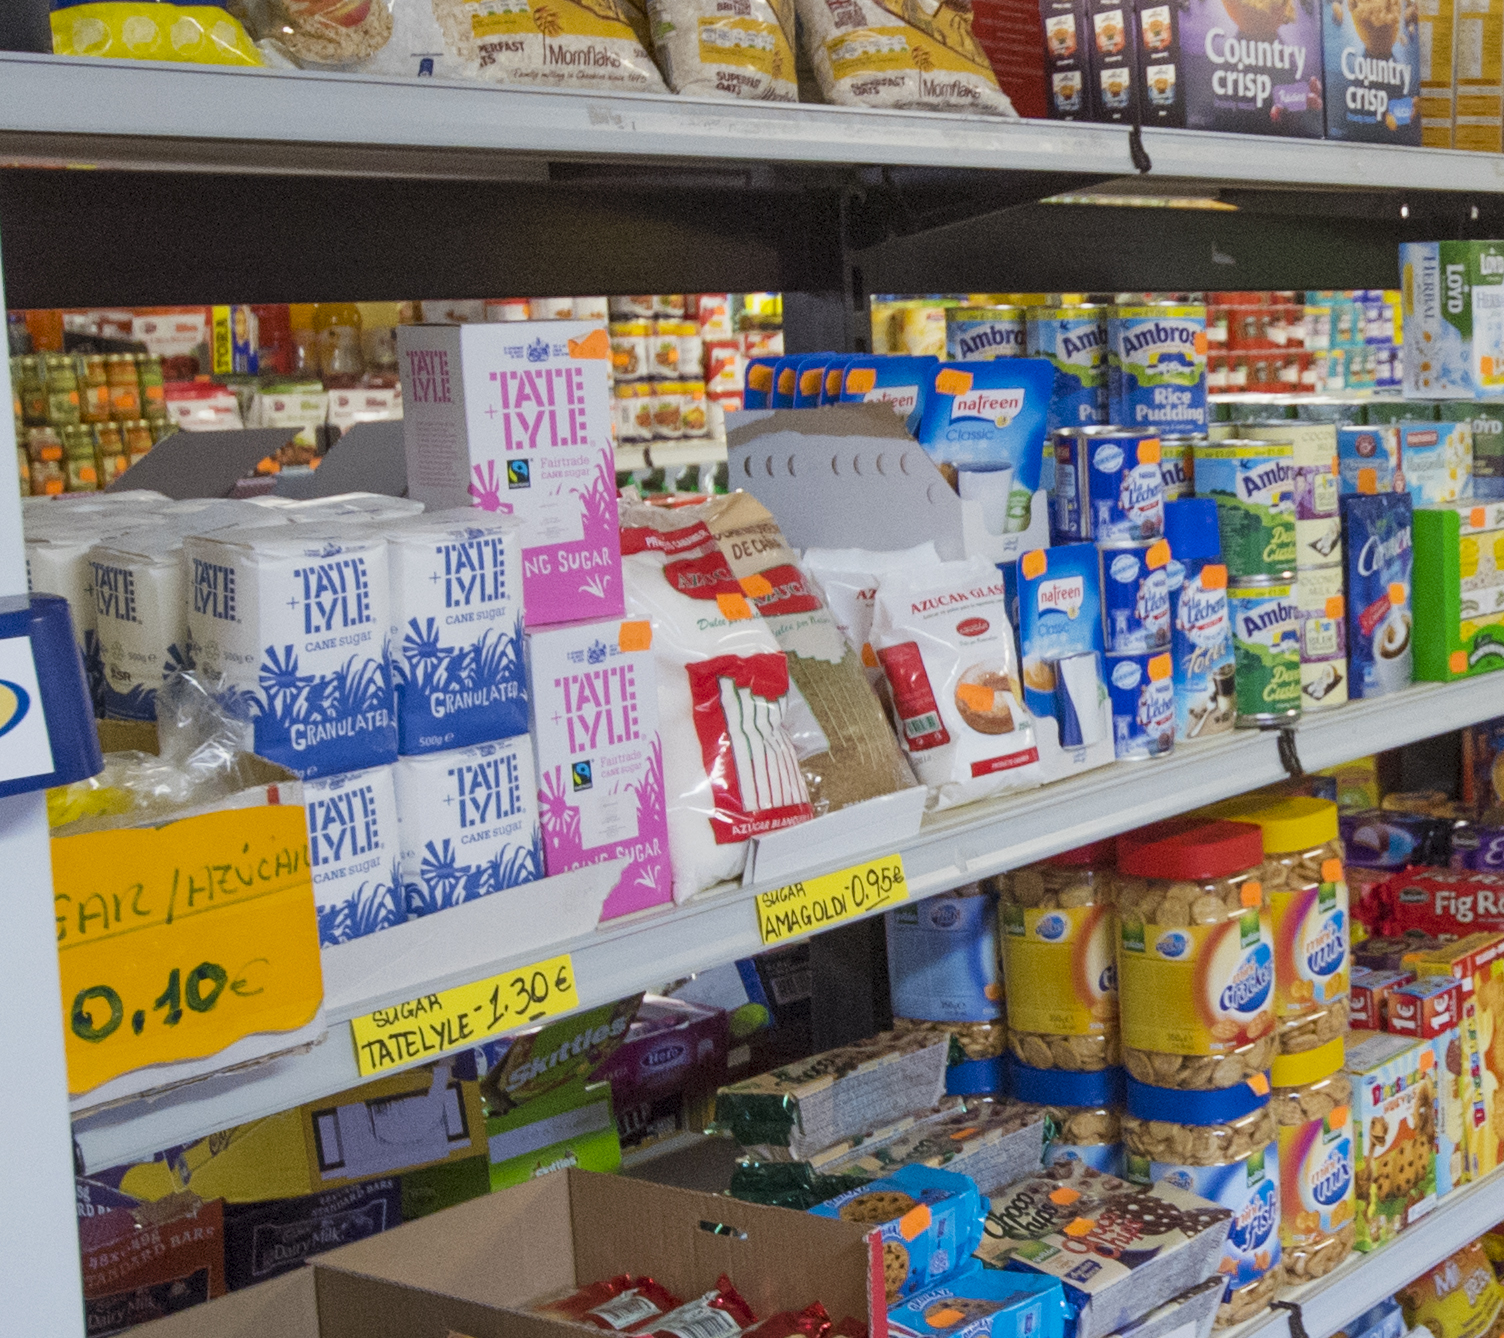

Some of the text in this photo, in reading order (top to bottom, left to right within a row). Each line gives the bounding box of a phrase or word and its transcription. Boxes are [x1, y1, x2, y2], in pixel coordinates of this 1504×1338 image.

[1205, 28, 1306, 77] Country
[1341, 47, 1413, 92] Country
[1212, 67, 1273, 112] crisp
[1346, 82, 1389, 114] crisp
[488, 367, 585, 409] TATE
[957, 393, 1018, 414] natreen
[1154, 387, 1192, 404] Rice
[502, 404, 589, 452] LYLE
[1136, 405, 1204, 423] Pudding
[539, 456, 590, 469] Fairtrade
[435, 538, 506, 577] TATE
[558, 548, 612, 573] SUGAR
[293, 558, 368, 599] TATE
[443, 572, 506, 609] LYLE
[1039, 583, 1082, 606] natreen
[303, 595, 373, 636] LYLE
[445, 604, 506, 626] CANE sugar
[305, 630, 373, 652] CANE sugar
[290, 708, 390, 751] GRANULATED
[761, 882, 806, 910] SUGAR
[1435, 891, 1474, 922] Fig
[371, 992, 444, 1030] SUGAR
[360, 1013, 470, 1070] TATELYLE
[504, 1015, 628, 1092] Skittles
